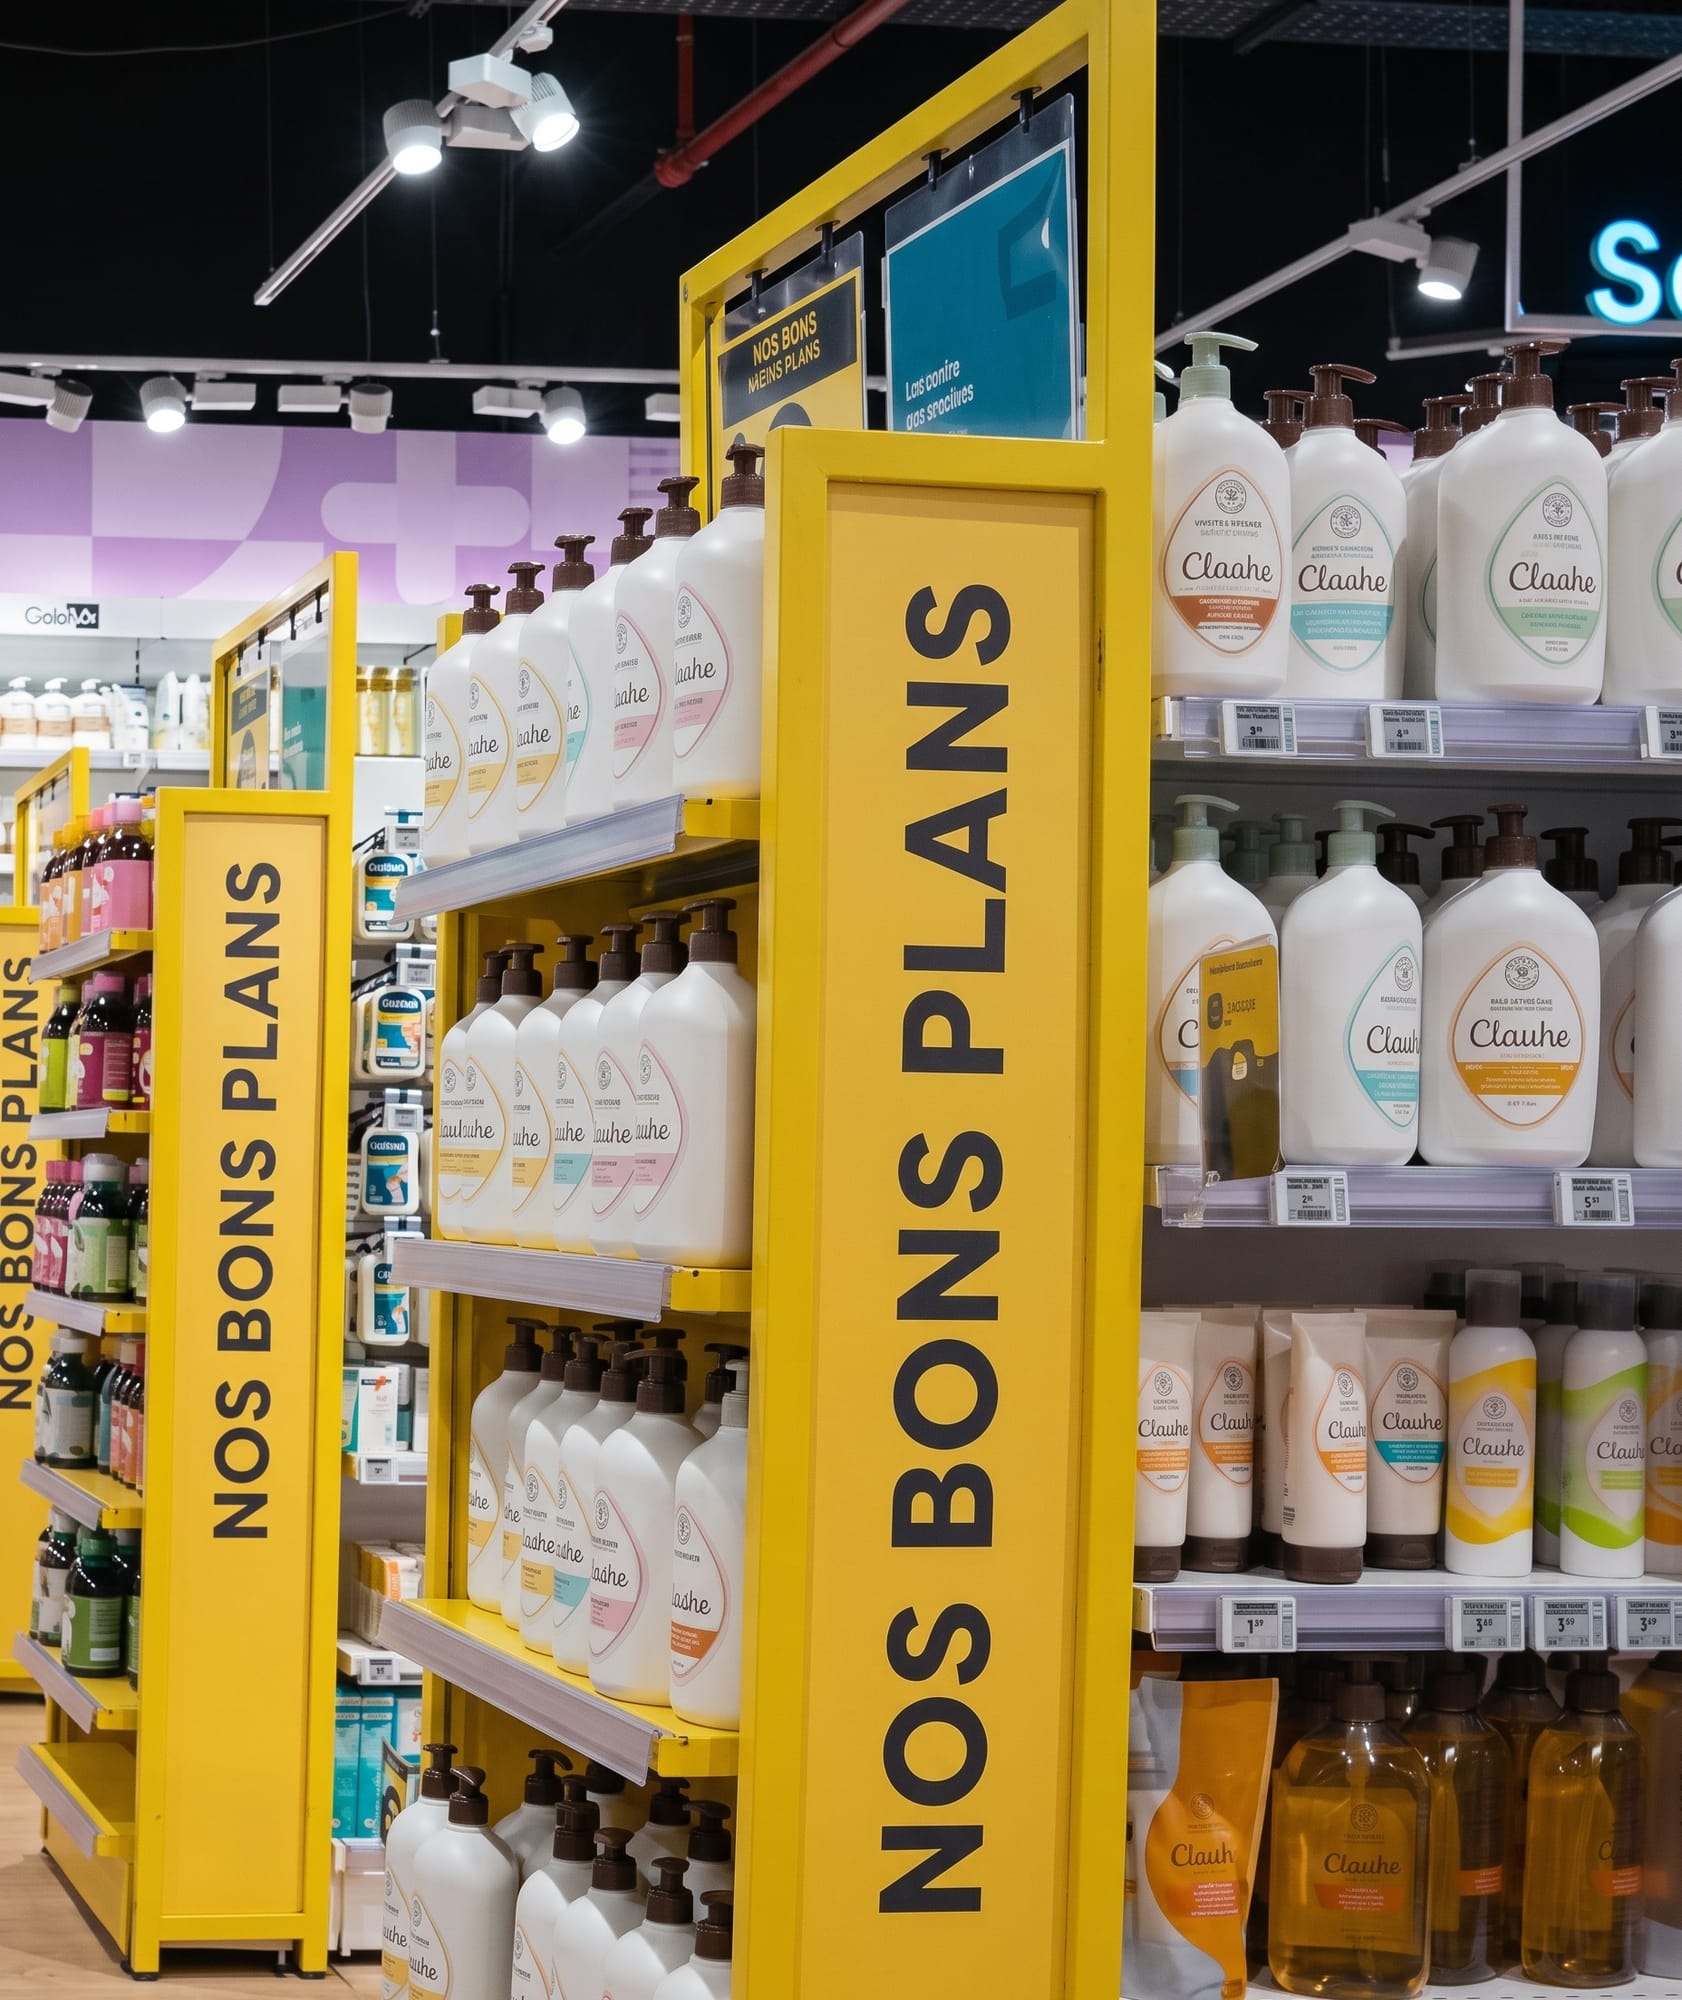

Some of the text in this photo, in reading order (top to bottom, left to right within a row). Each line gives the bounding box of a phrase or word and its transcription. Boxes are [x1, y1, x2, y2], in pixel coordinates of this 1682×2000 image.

[1584, 218, 1682, 326] S
[753, 310, 817, 367] NOS BONS
[785, 338, 821, 374] PLANS
[1182, 551, 1274, 582] Claahe
[1298, 564, 1388, 592] Claahe
[1509, 561, 1596, 593] Claahe
[2, 957, 39, 1123] PLANS
[1470, 1019, 1571, 1047] Clauhe
[0, 1144, 37, 1285] BONS
[213, 863, 281, 1538] NOS BONS PLANS
[879, 585, 1010, 1913] NOS BONS PLANS
[1138, 1419, 1189, 1437] Clauhe
[1210, 1412, 1260, 1431] Clauh
[1383, 1412, 1443, 1430] Clauhe
